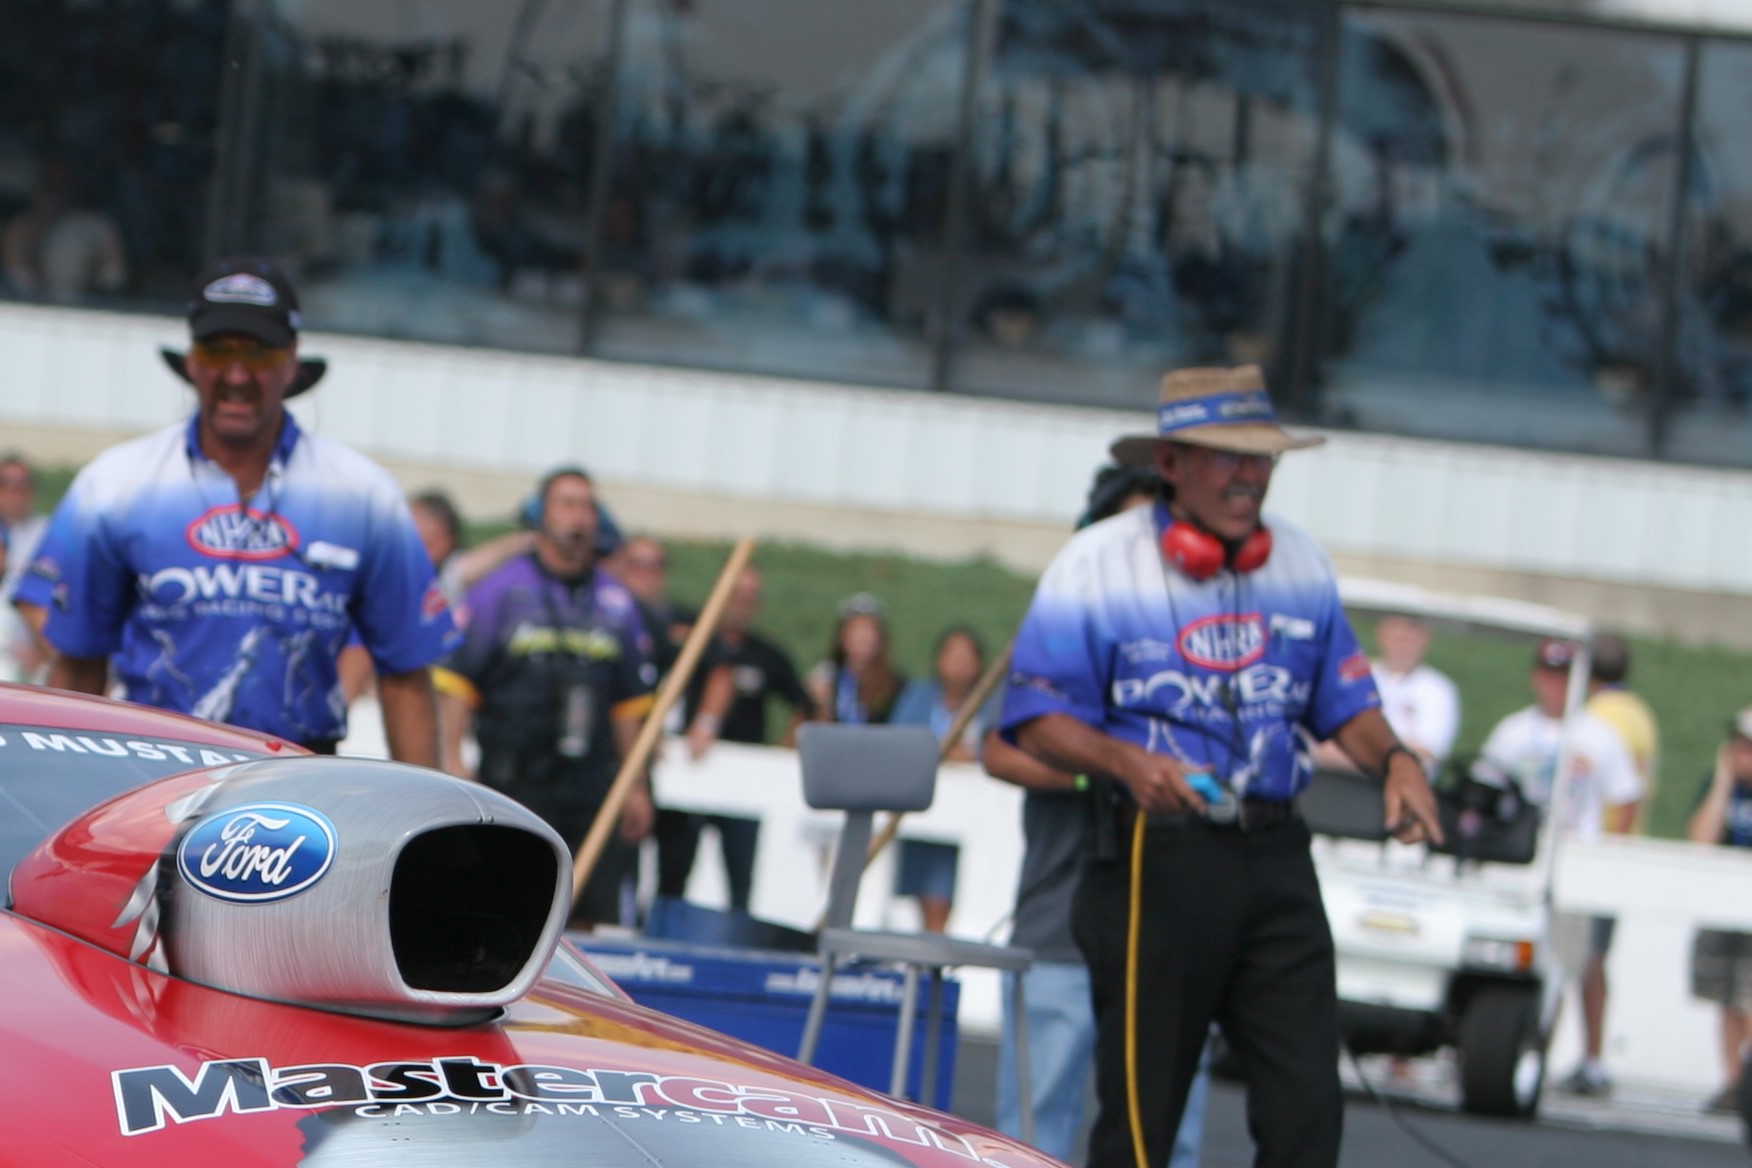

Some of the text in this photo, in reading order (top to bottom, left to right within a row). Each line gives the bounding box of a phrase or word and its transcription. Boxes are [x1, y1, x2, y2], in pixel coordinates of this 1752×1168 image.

[200, 812, 307, 886] Ford
[355, 1101, 836, 1140] CAD/CAM SYSTEMS
